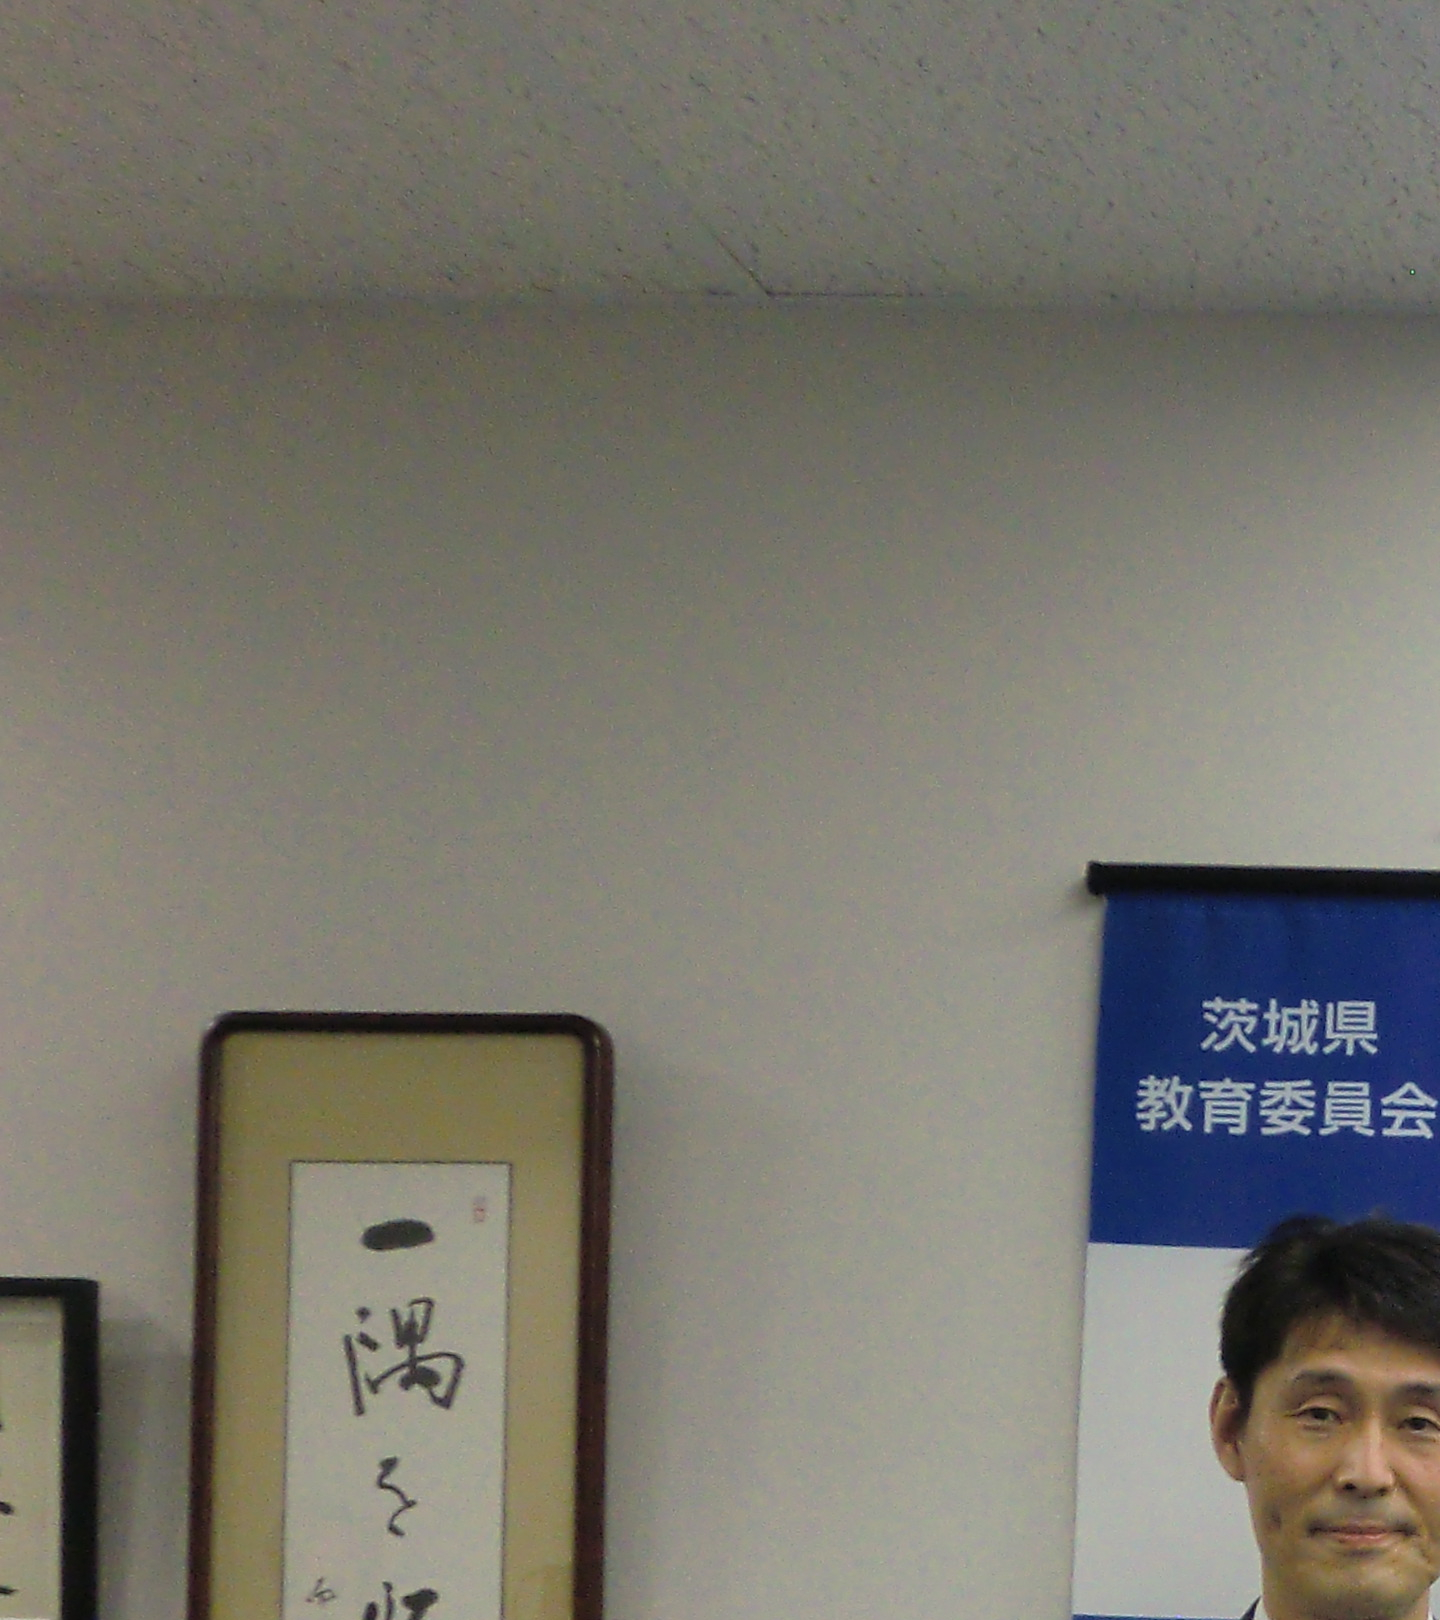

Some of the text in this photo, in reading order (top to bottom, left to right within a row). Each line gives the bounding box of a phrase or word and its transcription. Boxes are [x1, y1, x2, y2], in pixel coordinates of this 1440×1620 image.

[1201, 997, 1378, 1056] 茨城県
[1136, 1076, 1438, 1139] 教育委員会
